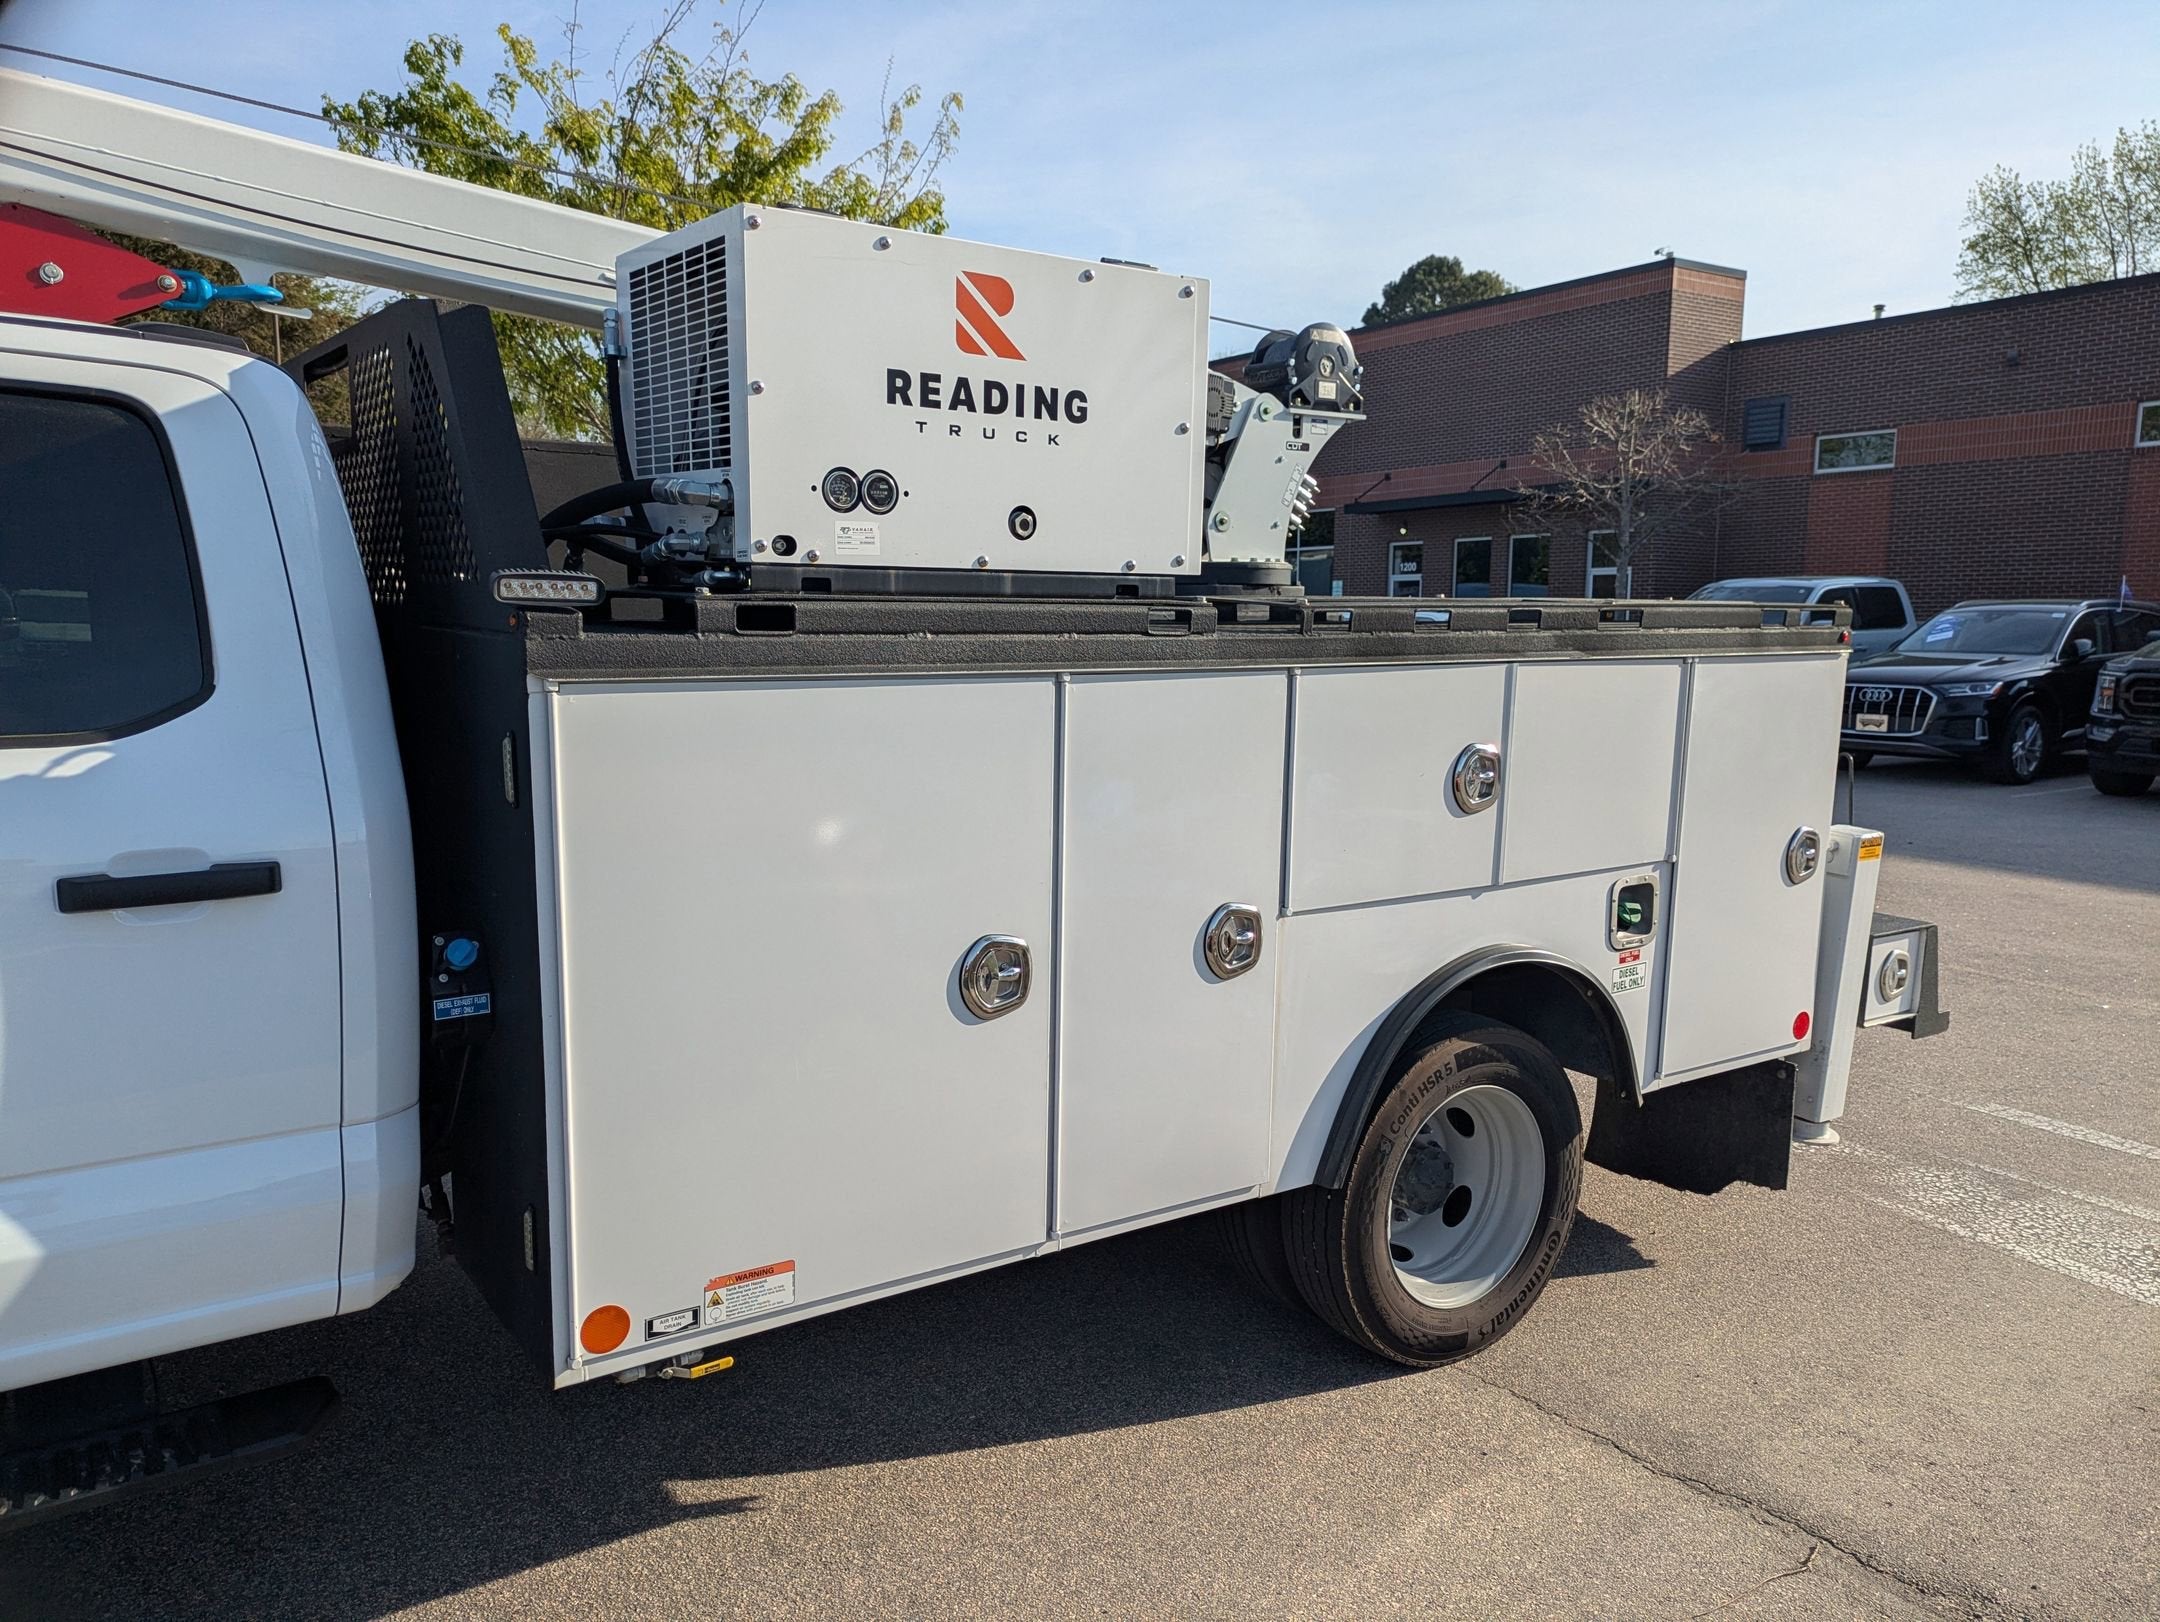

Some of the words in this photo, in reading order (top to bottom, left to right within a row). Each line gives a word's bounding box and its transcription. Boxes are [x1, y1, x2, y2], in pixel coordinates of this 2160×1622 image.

[887, 368, 1088, 424] READING
[915, 421, 1060, 446] TRUCK
[1400, 562, 1417, 571] 1200
[1619, 967, 1638, 979] DIESEL
[1613, 980, 1627, 990] FUEL
[1629, 976, 1644, 987] ONLY
[437, 1001, 453, 1009] DIESEL
[474, 996, 487, 1004] FLUID
[1390, 1093, 1420, 1135] Conti
[1417, 1069, 1444, 1098] HSR
[1443, 1062, 1453, 1076] 5
[735, 1267, 774, 1282] WARNING
[664, 1322, 681, 1330] DRAIN
